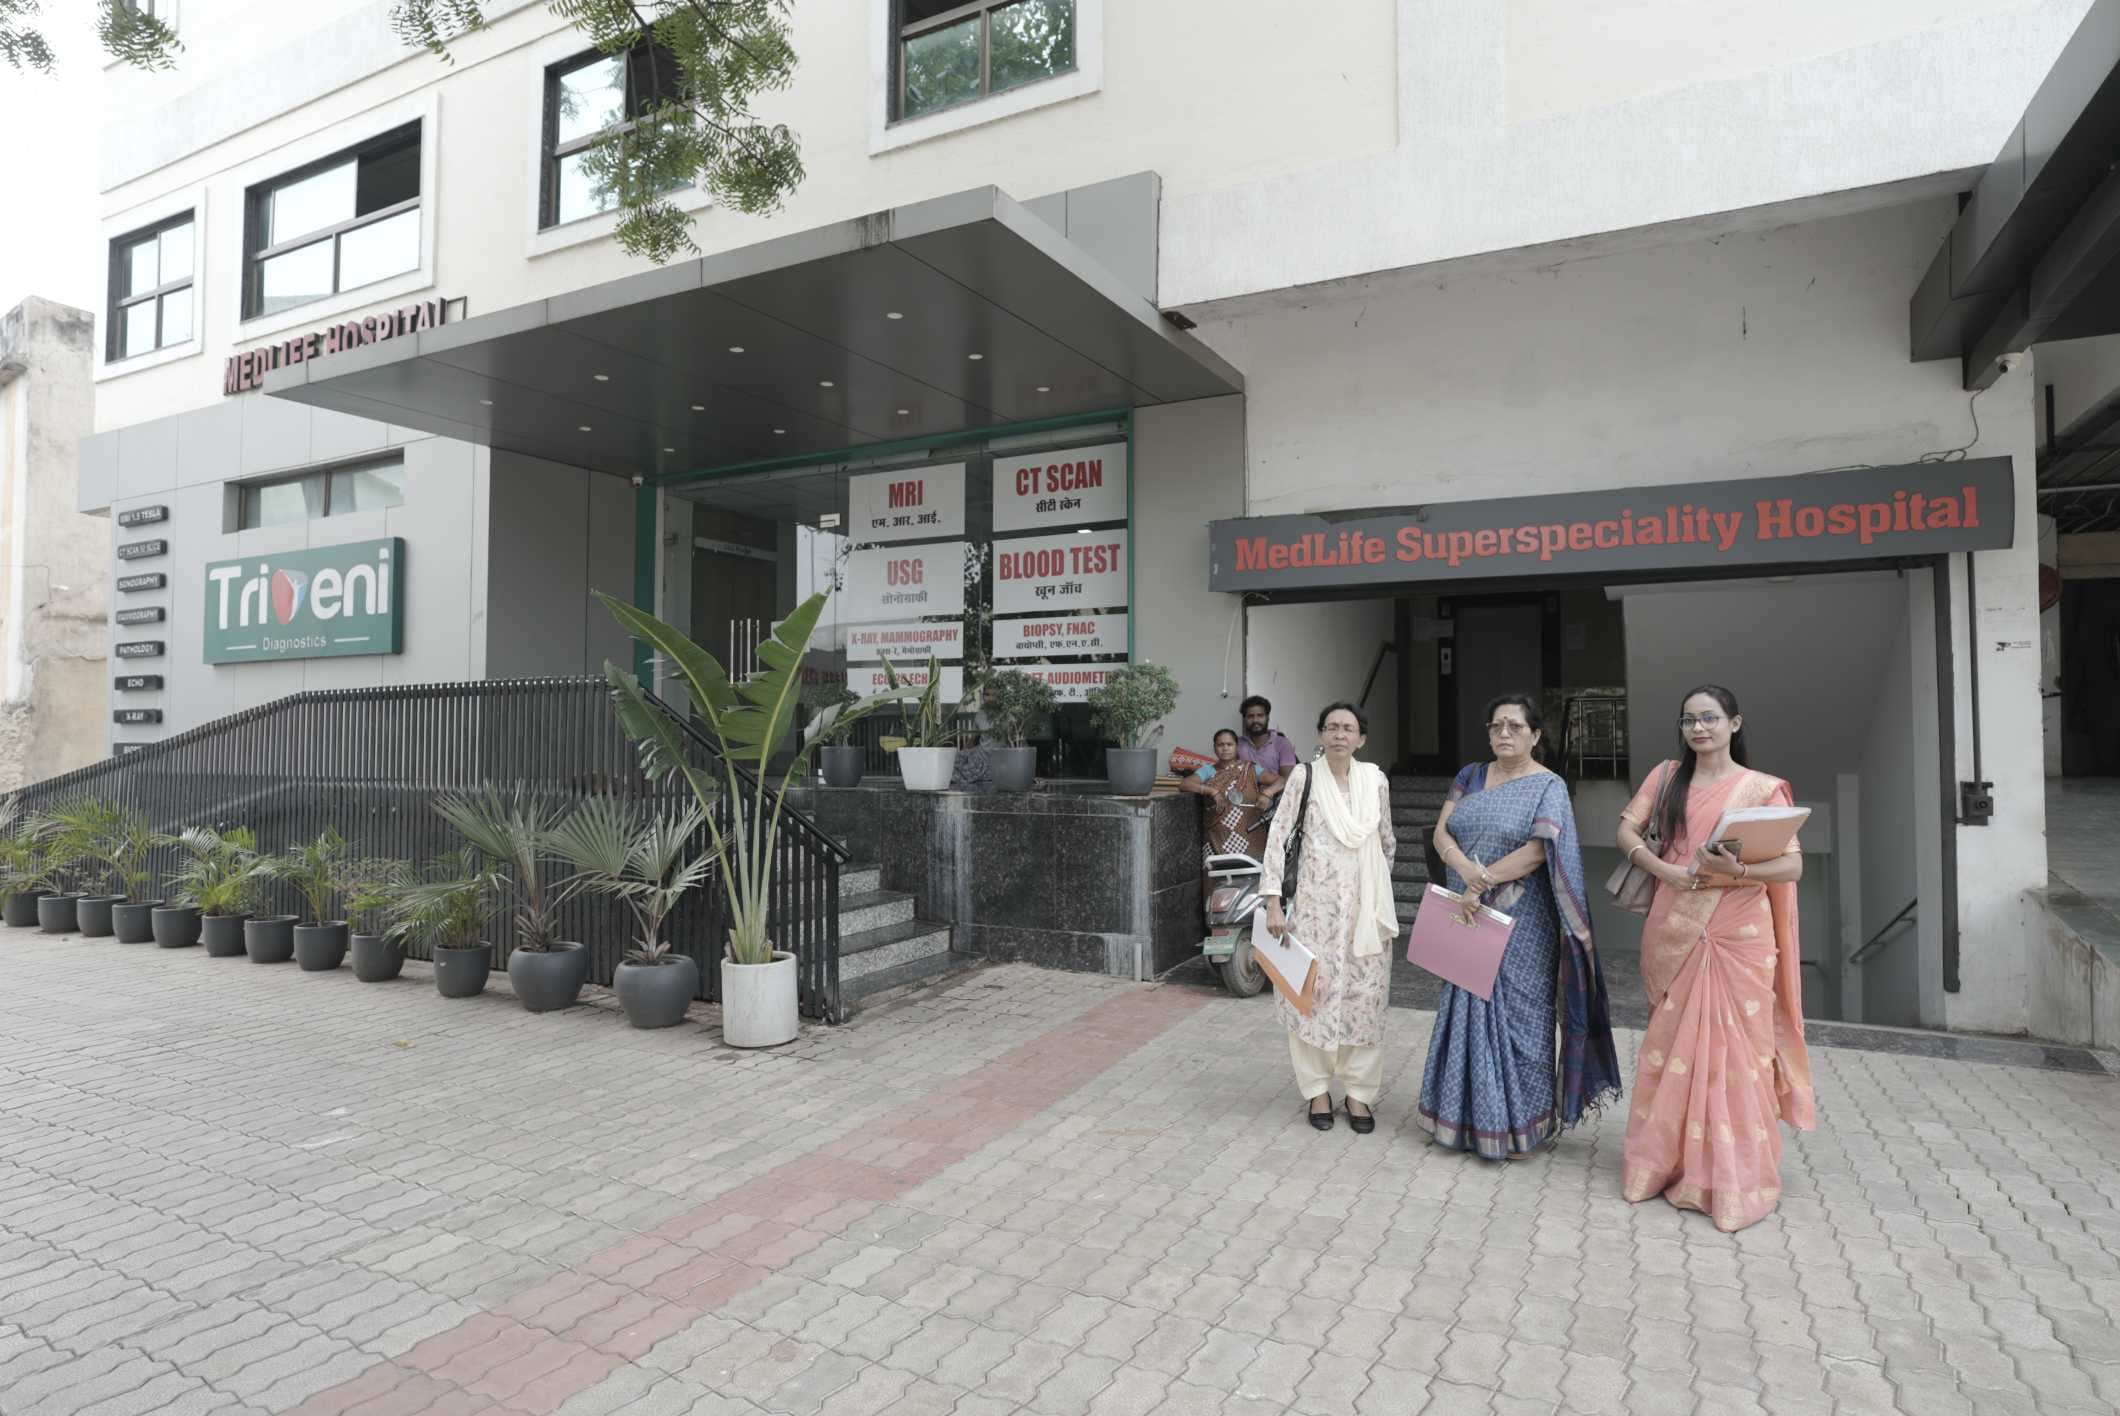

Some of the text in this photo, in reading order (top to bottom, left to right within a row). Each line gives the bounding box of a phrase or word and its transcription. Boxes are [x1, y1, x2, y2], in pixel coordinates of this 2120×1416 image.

[1016, 459, 1103, 496] CT SCAN
[888, 480, 923, 509] MRI
[1035, 499, 1057, 513] सीटी
[1235, 484, 1981, 573] MedLife Superspeciality Hospital
[1000, 544, 1121, 580] BLOOD TEST
[887, 559, 923, 586] USG
[119, 577, 157, 588] SONOGRAPHY
[1034, 585, 1056, 600] खून
[1066, 621, 1095, 635] FNAC
[262, 634, 328, 654] Diagnostics
[881, 629, 958, 644] MAMMOGRAPHY
[119, 644, 154, 655] PATHOLOGY
[127, 678, 144, 688] ECHO
[1047, 671, 1118, 684] AUDIOMET
[126, 711, 144, 721] X-RAY
